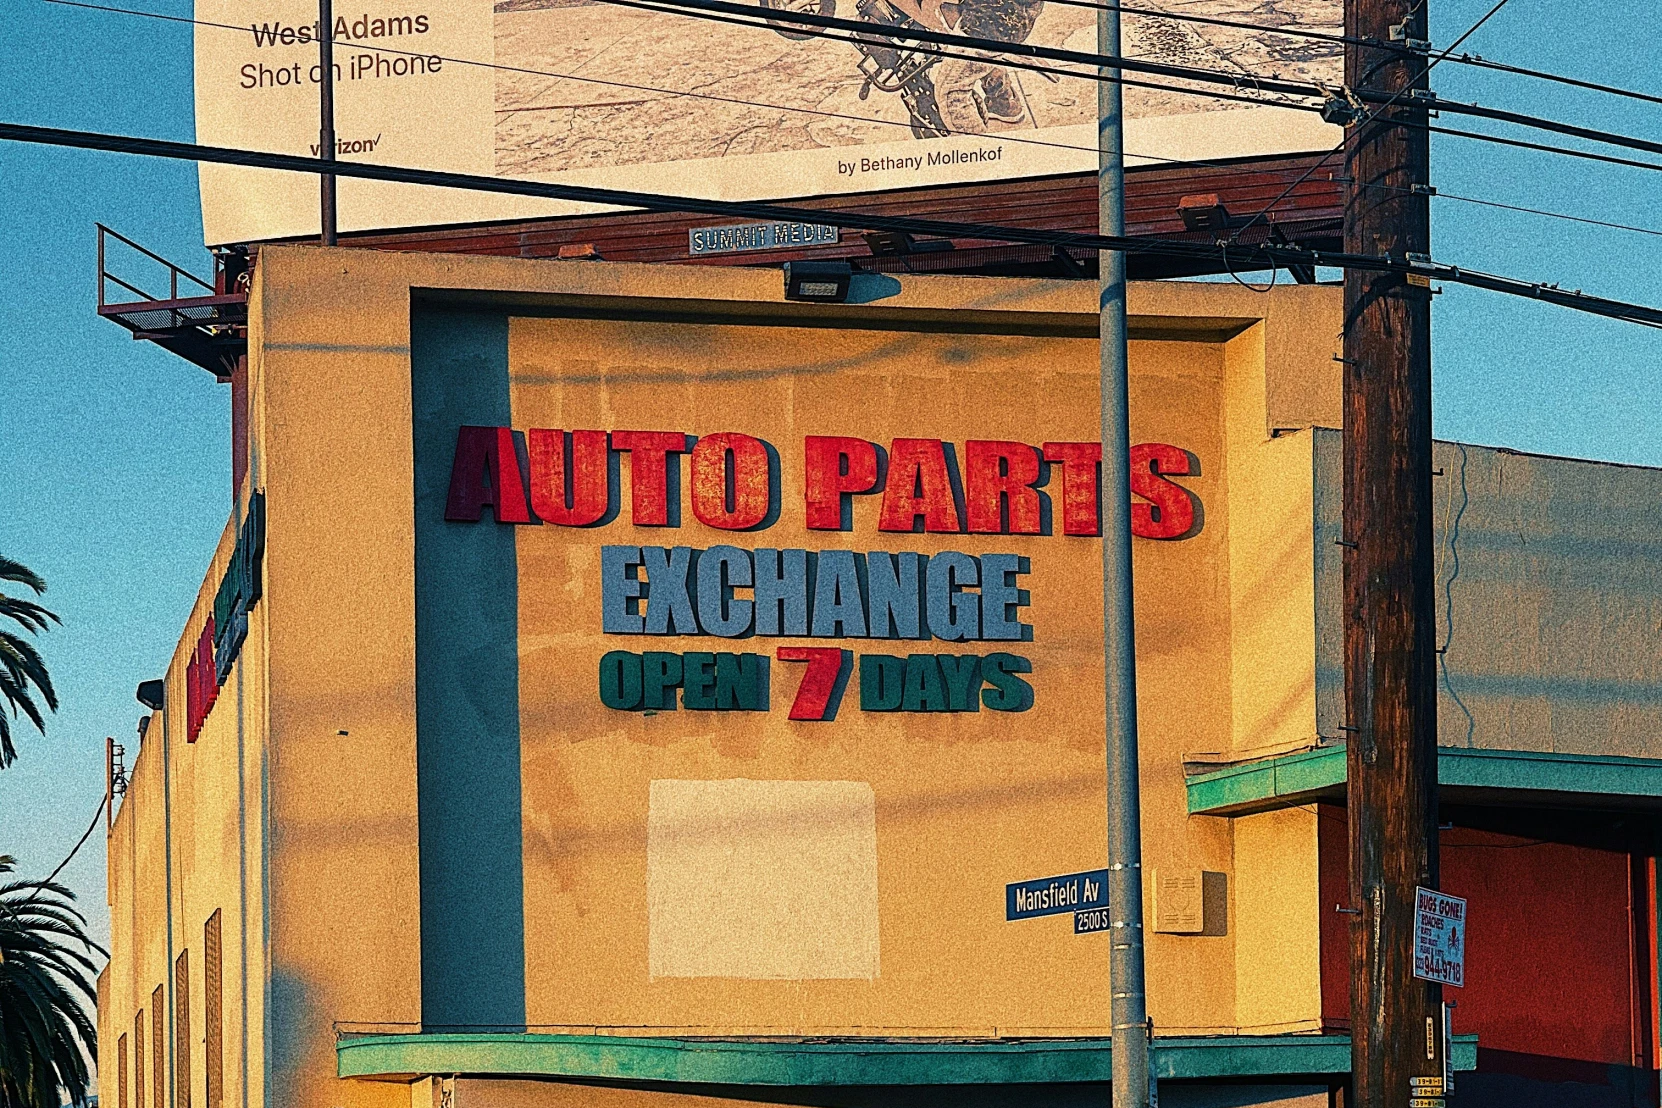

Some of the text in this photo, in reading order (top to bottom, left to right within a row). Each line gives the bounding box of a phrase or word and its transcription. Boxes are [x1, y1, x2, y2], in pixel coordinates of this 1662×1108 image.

[252, 14, 430, 48] West Adams
[240, 63, 302, 89] Shot
[350, 53, 443, 80] iPhone
[838, 146, 1003, 177] by Bethany Mollenkof
[694, 222, 835, 251] SUMMIT MEDIA
[444, 425, 1195, 541] AUTO PARTS
[601, 544, 1023, 642] EXCHANGE
[600, 646, 1027, 721] OPEN 7 DAYS
[1016, 877, 1100, 912] Mansfield Av
[1418, 893, 1463, 920] BUGS GONE!
[1077, 910, 1108, 931] 2500 S
[1424, 952, 1461, 983] 944-9718
